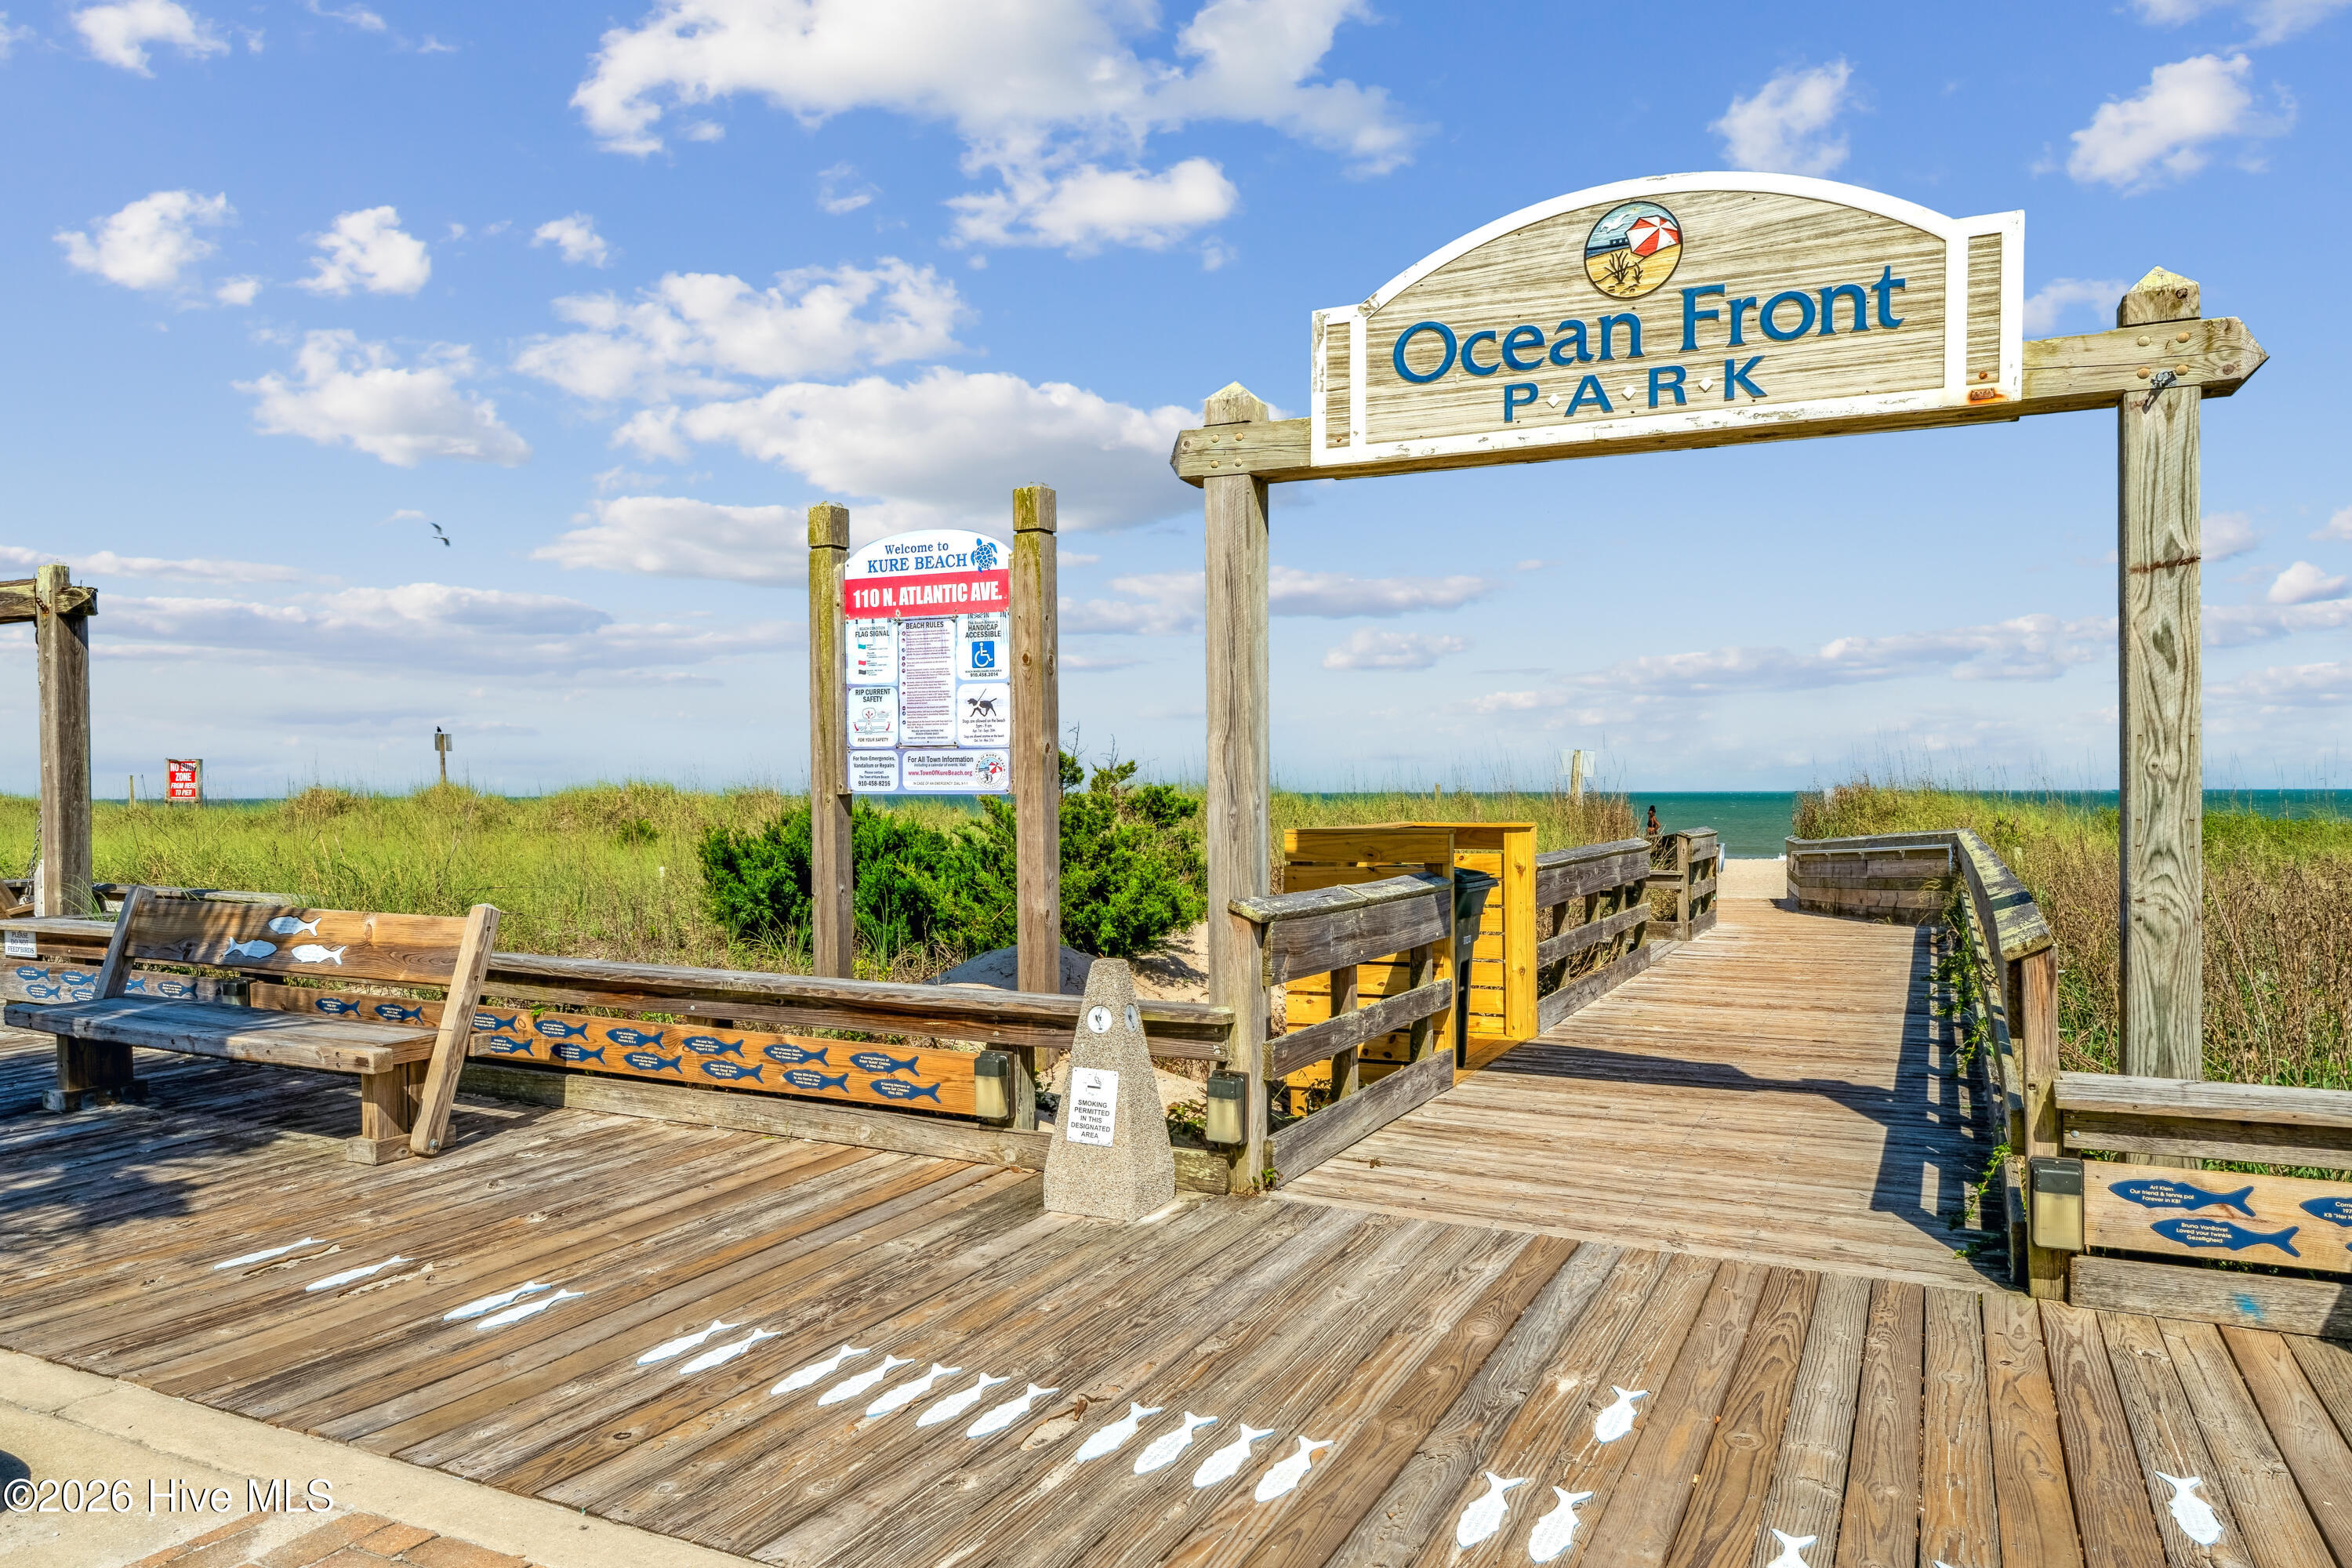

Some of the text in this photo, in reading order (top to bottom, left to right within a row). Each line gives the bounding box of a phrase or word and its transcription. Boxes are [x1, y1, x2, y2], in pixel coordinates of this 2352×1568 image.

[1393, 265, 1906, 385] Ocean Front
[885, 542, 949, 554] Welcome to
[868, 554, 967, 573] KURE BEACH
[853, 581, 1002, 608] 110 N. ATLANTIC AVE.
[170, 763, 179, 771] NO
[176, 772, 191, 782] ZONE
[1078, 1099, 1107, 1108] SMOKING
[1074, 1107, 1109, 1116] PERMITTED
[1071, 1122, 1110, 1132] DESIGNATED
